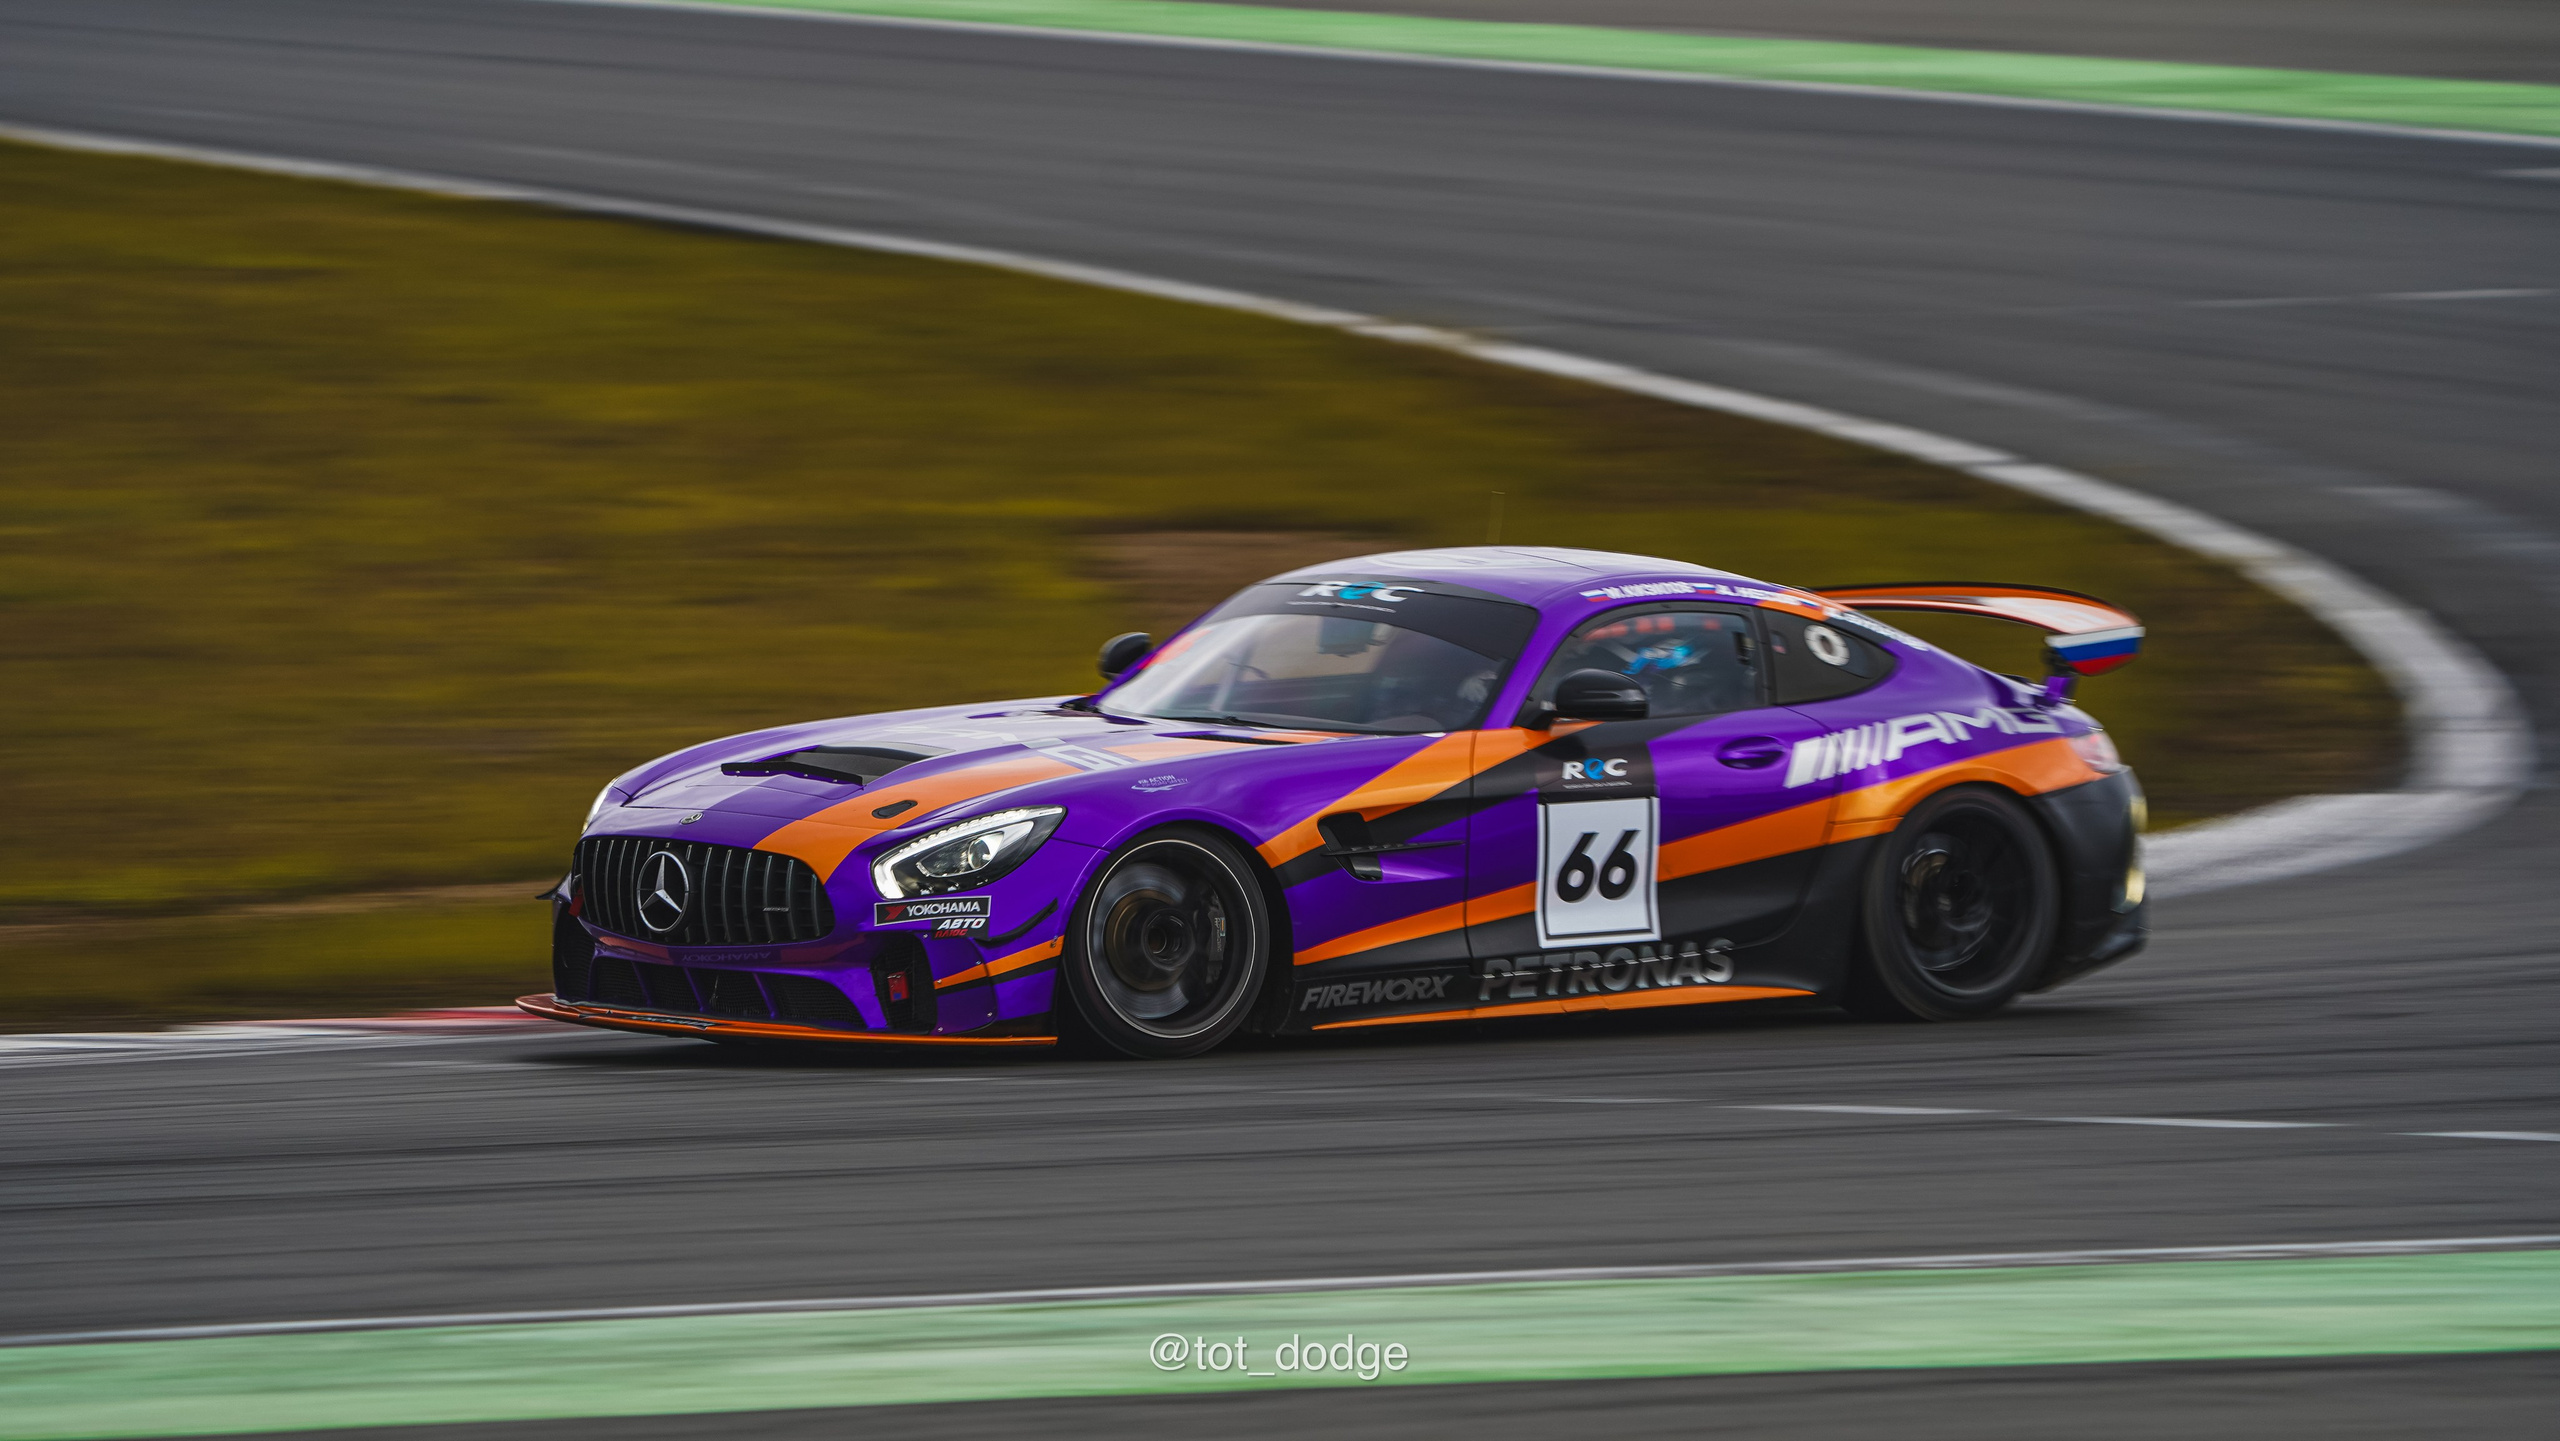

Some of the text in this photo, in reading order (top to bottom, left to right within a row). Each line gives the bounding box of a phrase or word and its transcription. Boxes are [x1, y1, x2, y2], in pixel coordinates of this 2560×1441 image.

[1556, 829, 1641, 904] 66
[906, 901, 981, 917] YOKOHAMA
[1300, 975, 1454, 1011] FIREWORX
[1479, 938, 1734, 1000] PETRONAS
